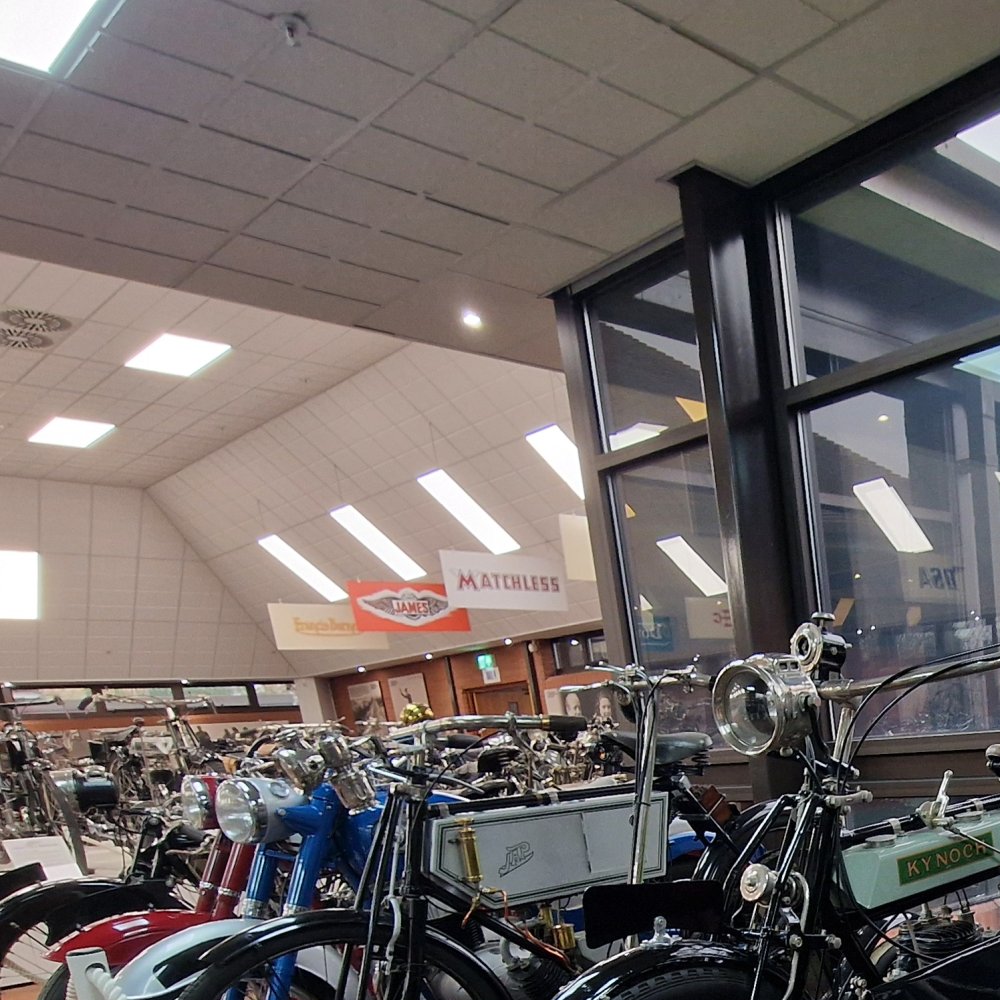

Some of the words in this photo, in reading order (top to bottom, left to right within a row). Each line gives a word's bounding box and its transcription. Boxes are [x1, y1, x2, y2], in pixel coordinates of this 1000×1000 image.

[458, 570, 560, 593] MATCHLESS
[394, 599, 429, 614] JAMES
[908, 839, 987, 877] KYNOCH
